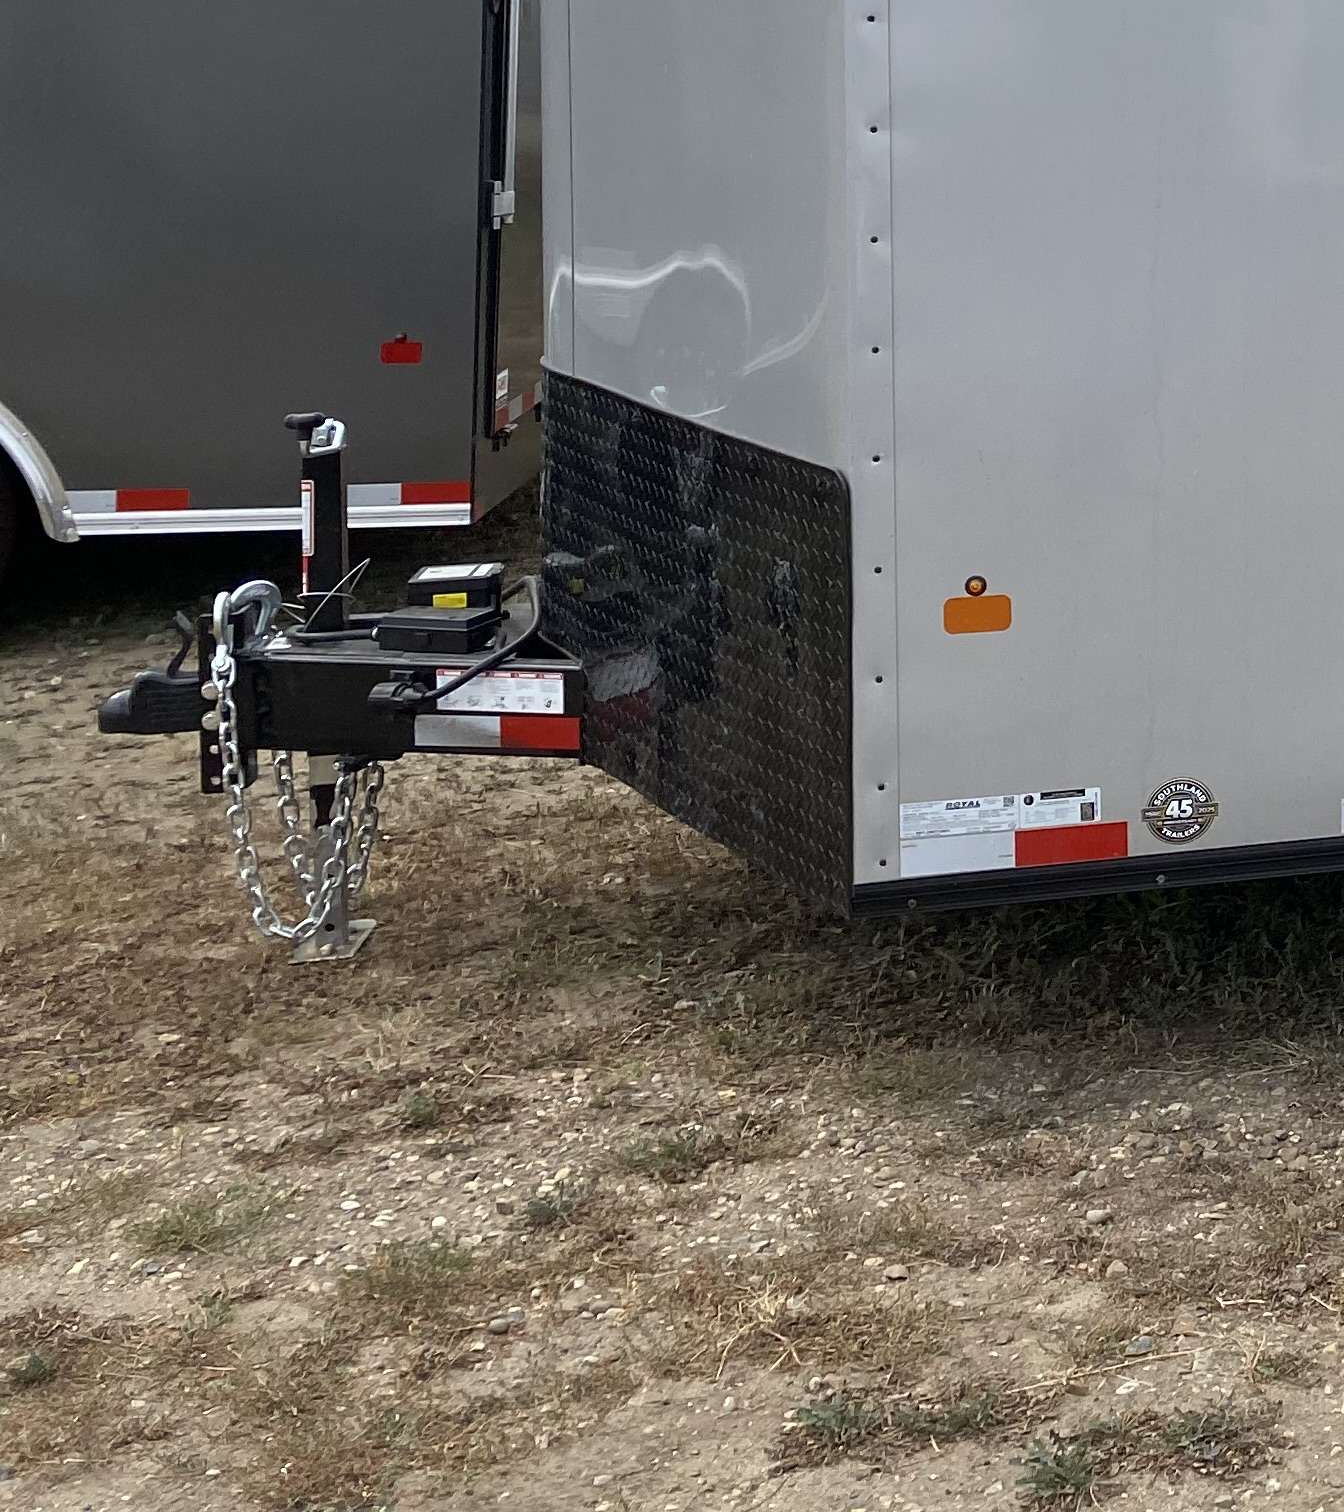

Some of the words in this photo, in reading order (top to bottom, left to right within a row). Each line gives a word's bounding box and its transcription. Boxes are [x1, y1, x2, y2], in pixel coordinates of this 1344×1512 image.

[1153, 783, 1207, 807] SOUTHLAND
[1165, 798, 1193, 819] 45
[1161, 824, 1200, 838] TRAILERS
